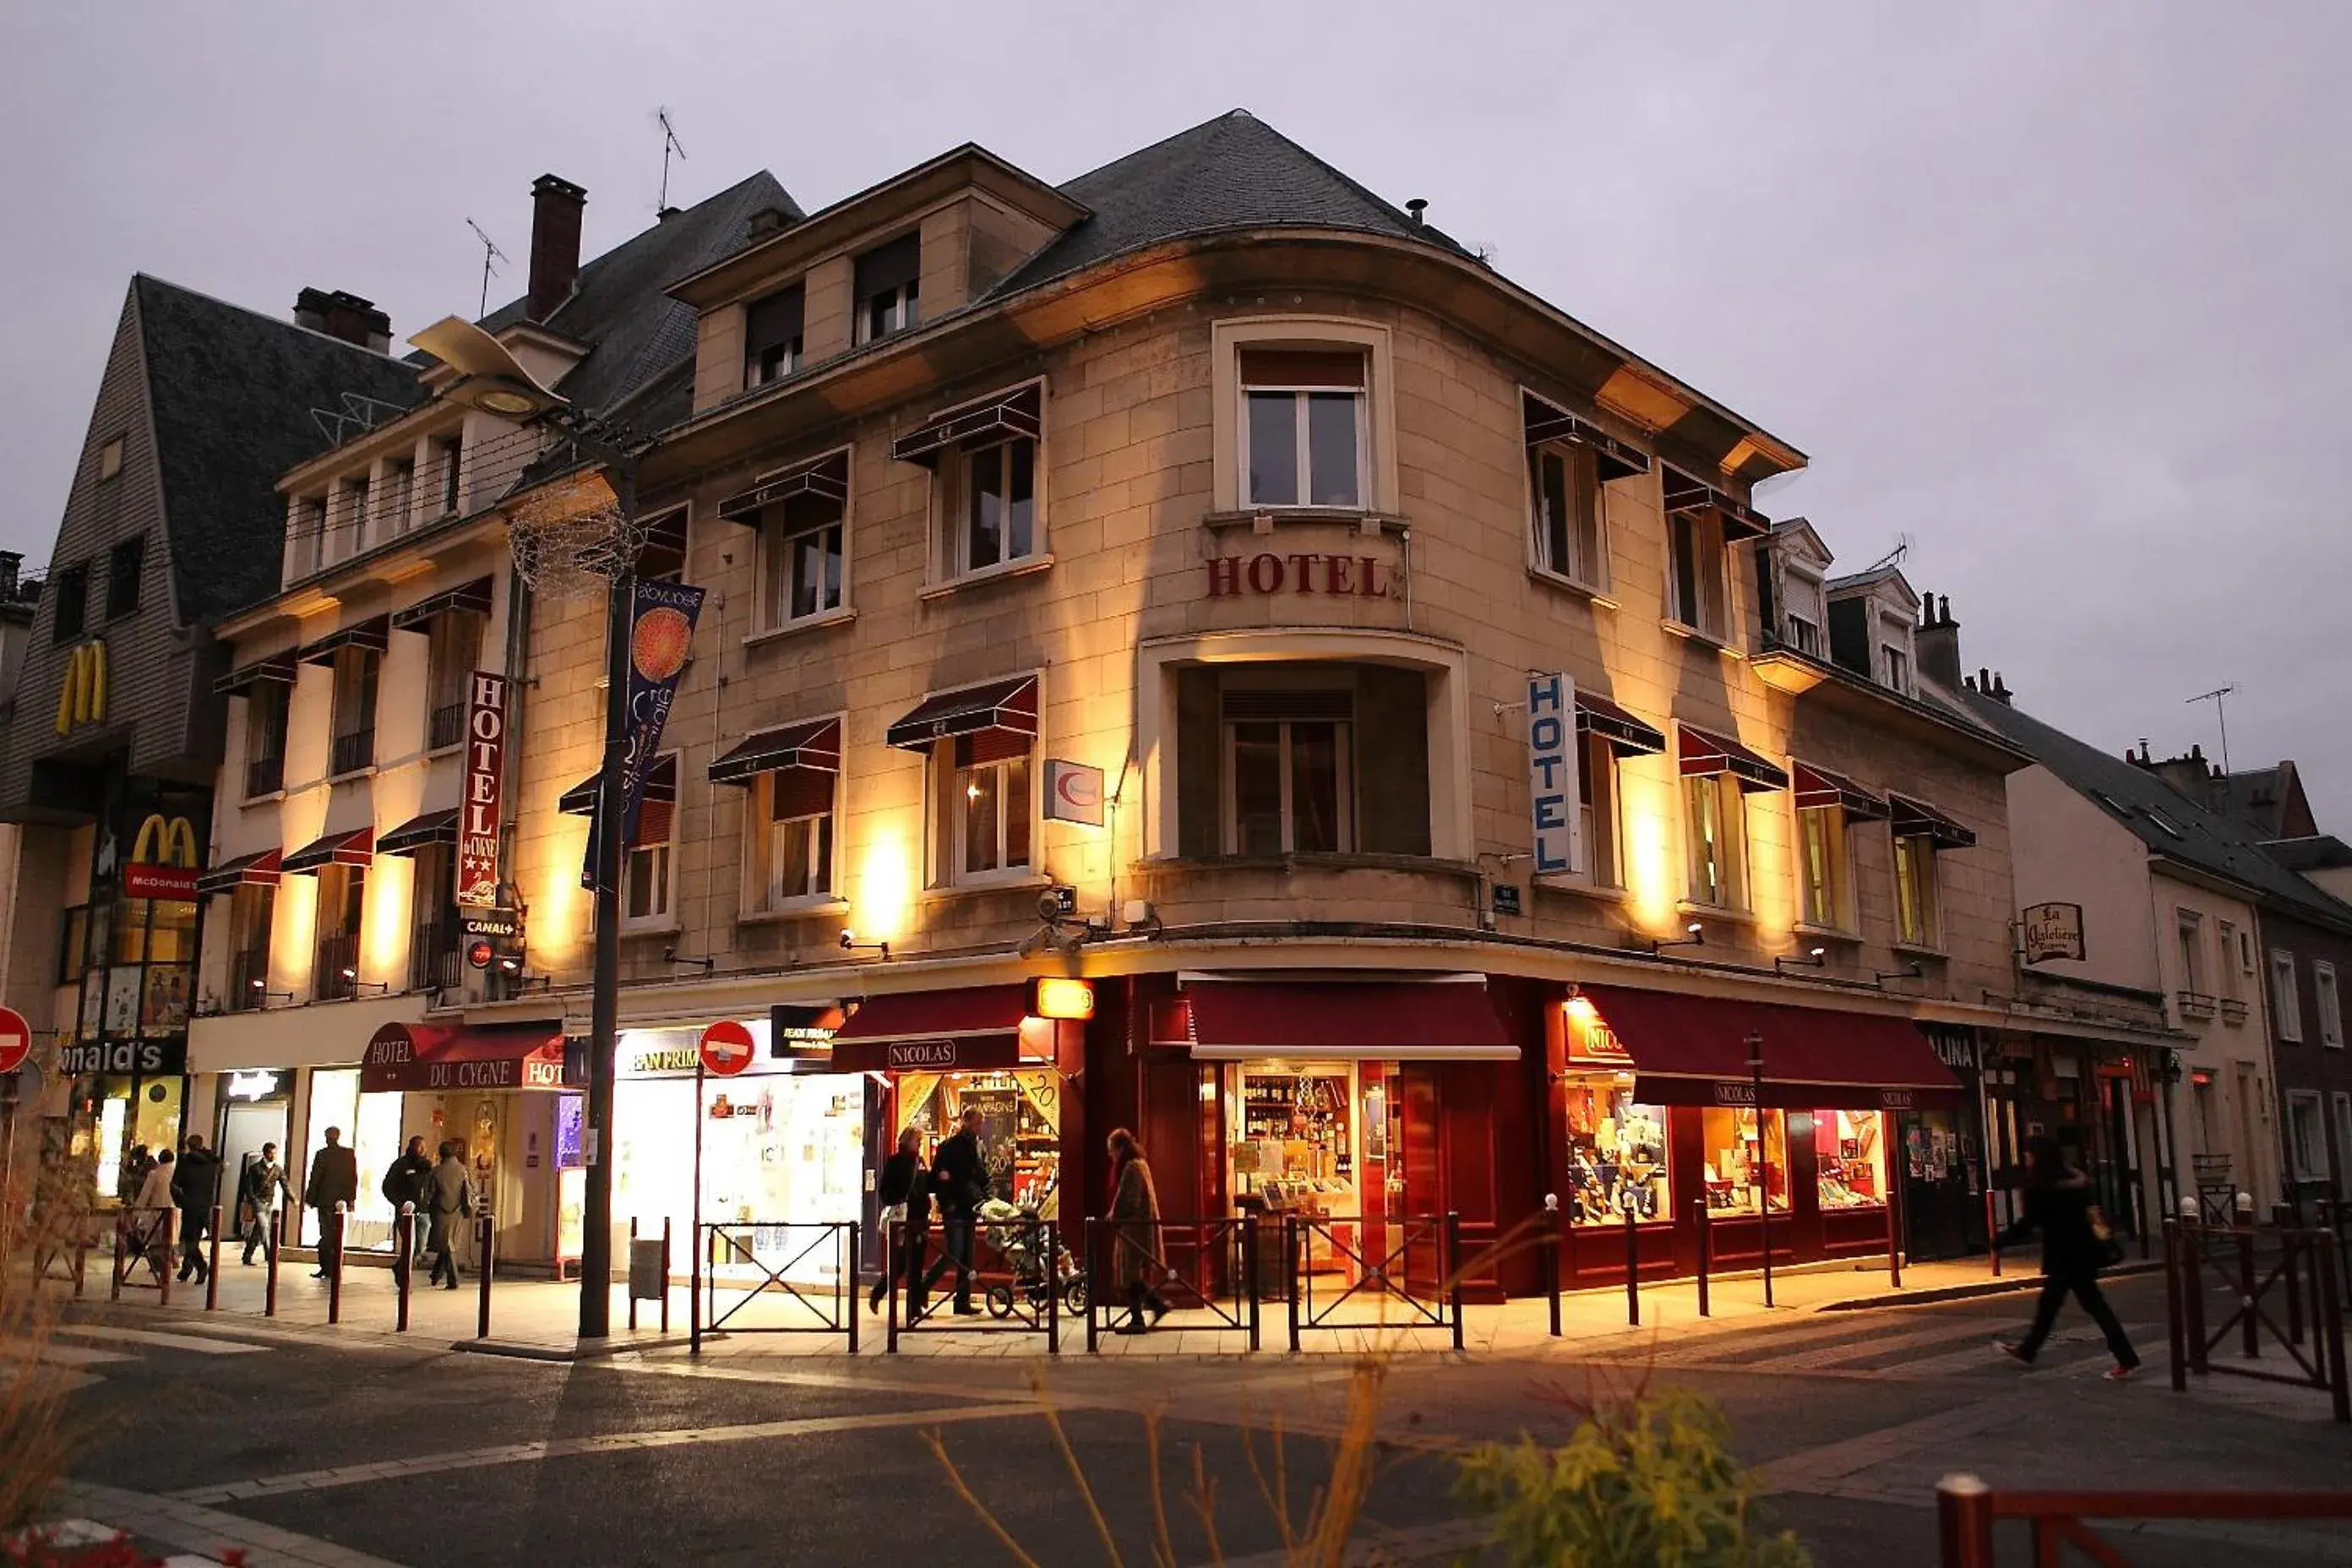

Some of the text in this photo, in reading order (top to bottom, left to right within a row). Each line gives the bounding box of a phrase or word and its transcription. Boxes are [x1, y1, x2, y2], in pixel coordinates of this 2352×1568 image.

[1206, 553, 1387, 596] HOTEL
[470, 676, 504, 836] HOTEL
[1530, 677, 1566, 870] HOTEL
[471, 836, 497, 858] CYGNE
[466, 921, 514, 935] CANAL+
[372, 1040, 411, 1065] HOTEL
[892, 1044, 953, 1064] NICOLAS
[430, 1061, 509, 1086] DU CYGNE
[1718, 1086, 1756, 1102] NICOLAS
